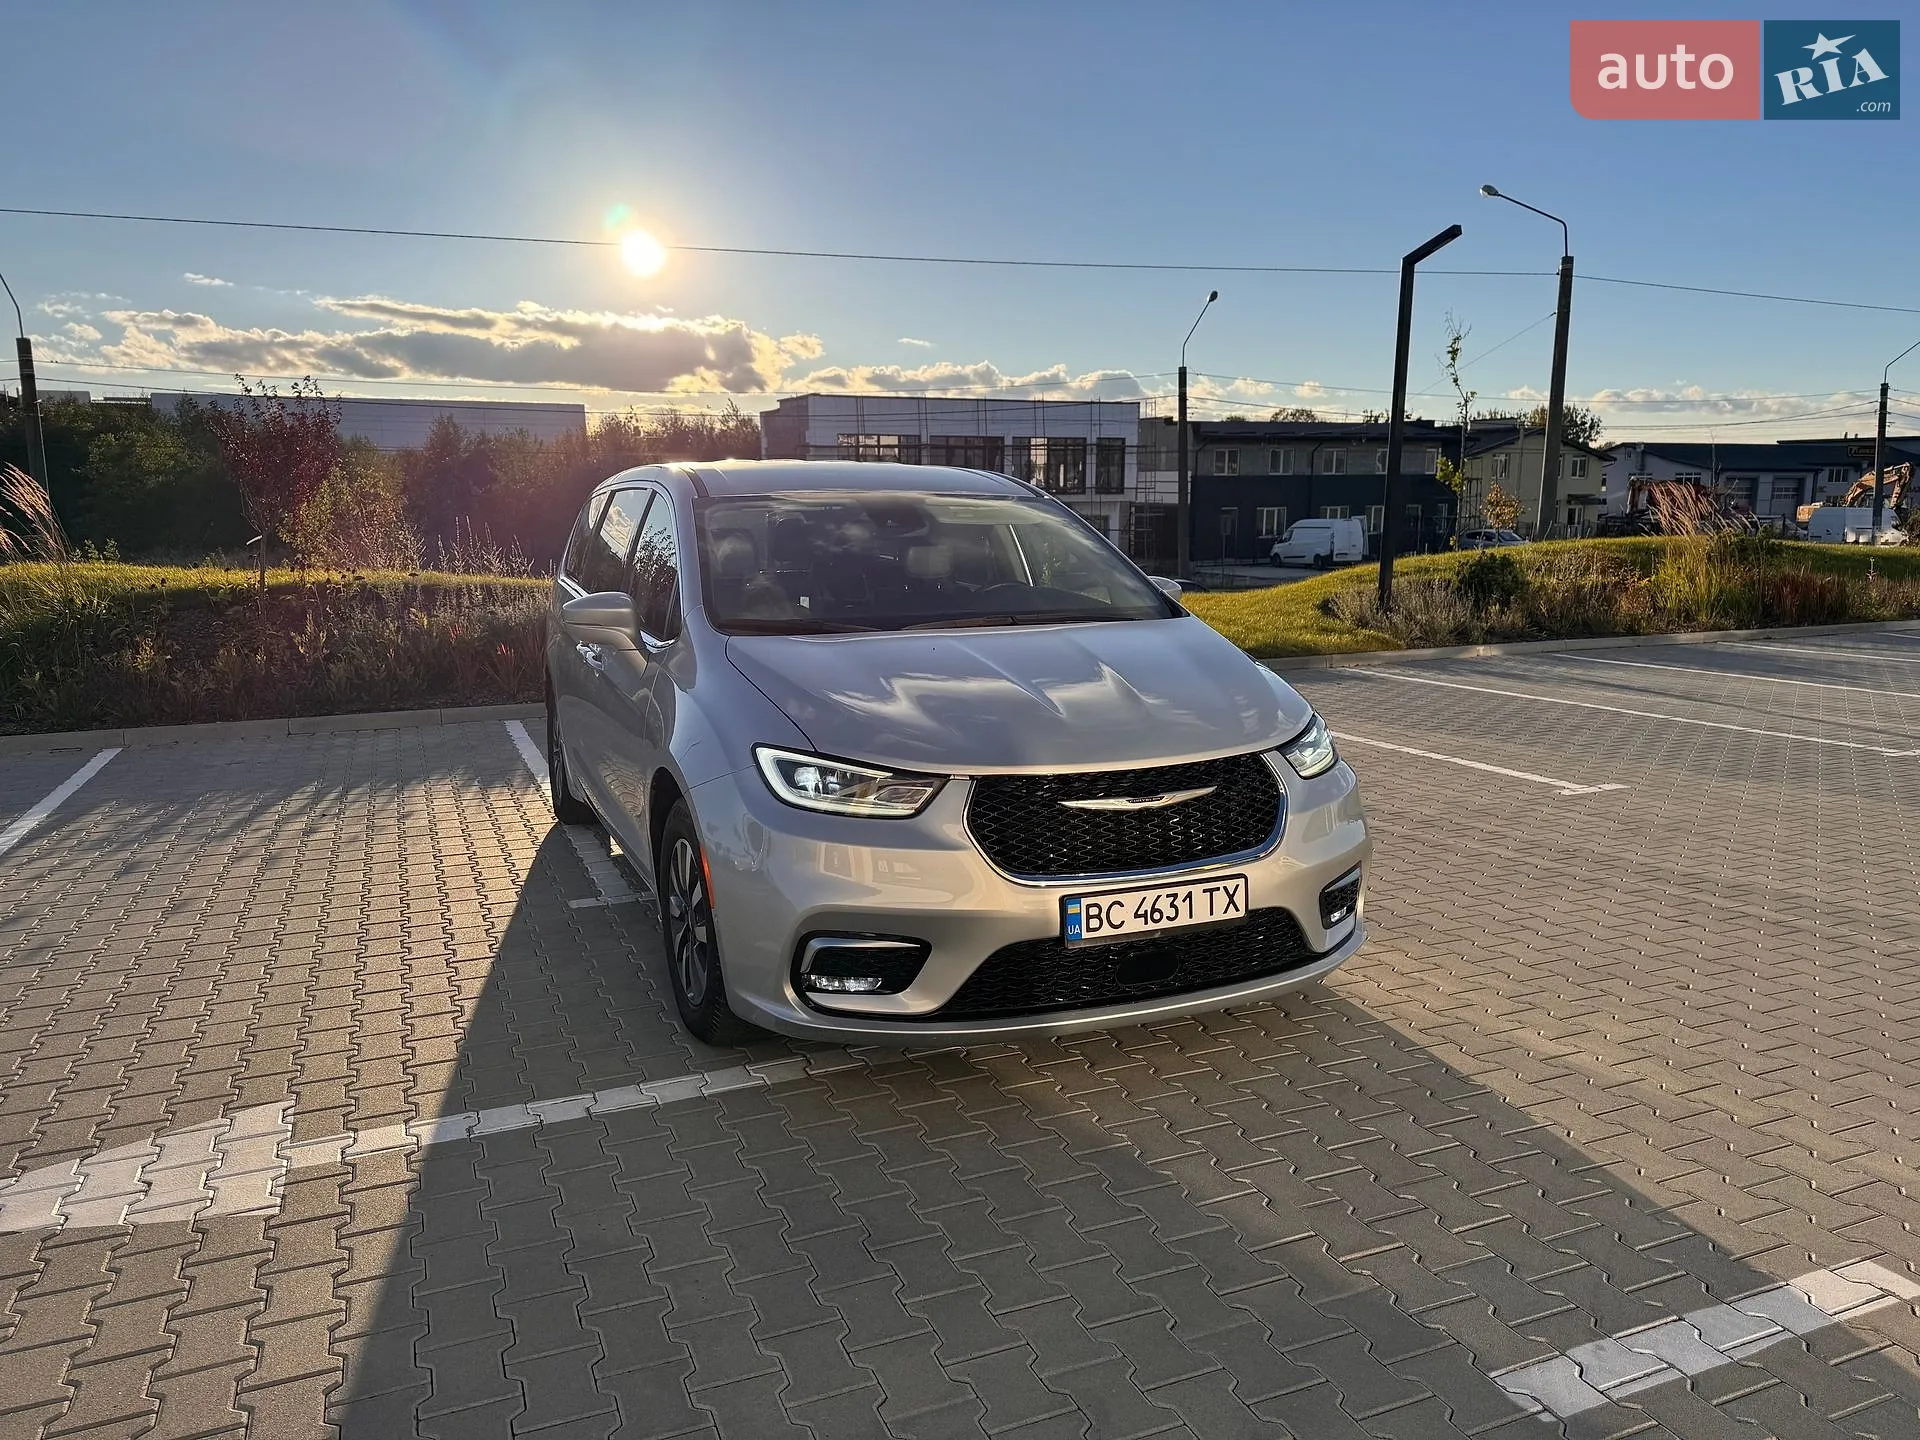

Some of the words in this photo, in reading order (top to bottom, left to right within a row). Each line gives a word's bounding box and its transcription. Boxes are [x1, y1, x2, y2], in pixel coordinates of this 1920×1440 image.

[1085, 900, 1126, 933] BC
[1133, 890, 1194, 926] 4631
[1202, 883, 1241, 917] TX
[1067, 924, 1081, 936] UA
